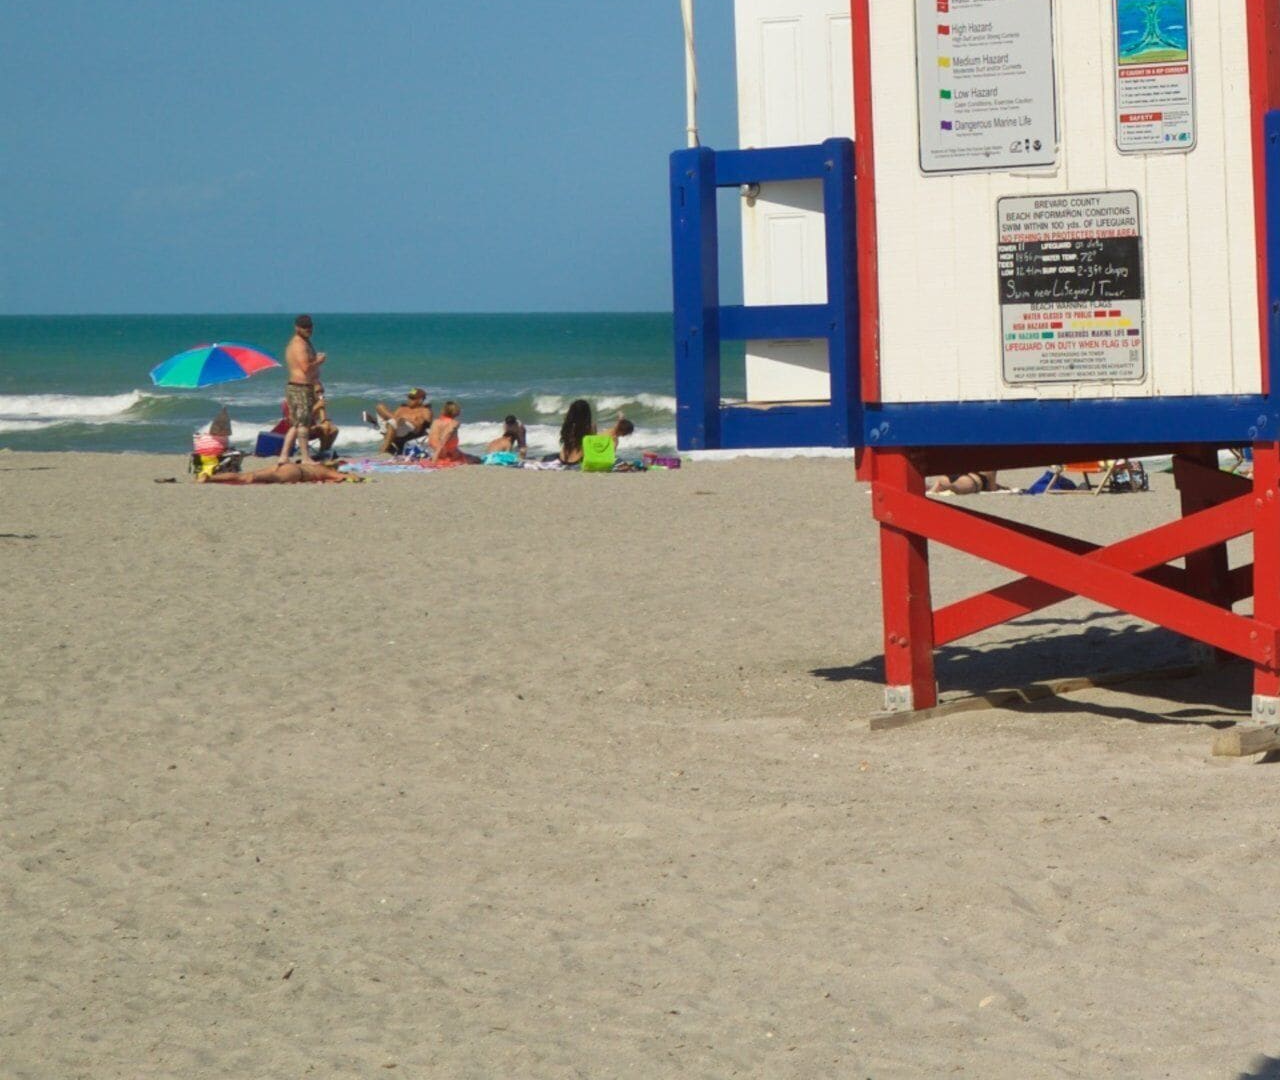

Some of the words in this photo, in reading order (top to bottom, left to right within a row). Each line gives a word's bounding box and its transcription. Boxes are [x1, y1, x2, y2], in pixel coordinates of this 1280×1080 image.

[952, 23, 967, 36] High
[968, 22, 993, 32] Hazard
[953, 56, 981, 67] Medium
[982, 53, 1009, 64] Hazard
[954, 88, 970, 99] Low
[971, 87, 998, 98] Hazard
[955, 120, 993, 132] Dangerous
[994, 117, 1018, 128] Marine
[1019, 115, 1033, 126] Life
[1129, 114, 1154, 122] SAFETY
[1035, 200, 1067, 210] BREVARD
[1070, 198, 1101, 208] COUNTY
[1006, 212, 1031, 222] BEACH
[1033, 209, 1082, 220] INFORMATION
[1085, 206, 1130, 217] CONDITIONS
[1002, 223, 1021, 232] SWIM
[1023, 221, 1049, 231] WITHIN
[1051, 220, 1064, 230] 100
[1067, 220, 1080, 230] yds.
[1084, 219, 1094, 228] OF
[1096, 217, 1136, 228] LIFEGUARD
[1002, 234, 1013, 243] NO
[1015, 232, 1041, 242] FISHING
[1043, 231, 1051, 240] IN
[1052, 229, 1094, 240] PROTECTED
[1095, 228, 1116, 238] SWIM
[1117, 227, 1137, 237] AREA
[1041, 241, 1072, 250] LIFEGUARD
[1006, 279, 1030, 299] Swim
[1034, 289, 1052, 298] near
[1052, 279, 1096, 299] Lifeguard
[1030, 302, 1054, 312] BEACH
[1056, 301, 1088, 310] WARNING
[1023, 313, 1041, 321] WATER
[1043, 312, 1063, 320] CLOSED
[1073, 311, 1092, 319] PUBLIC
[1013, 323, 1026, 331] HIGH
[1027, 322, 1049, 330] HAZARD
[1005, 332, 1016, 340] LOW
[1019, 332, 1041, 340] HAZARD
[1057, 330, 1089, 339] DANGEROUS
[1091, 329, 1112, 338] MARINE
[1114, 328, 1125, 337] LIFE
[1005, 341, 1043, 352] LIFEGUARD
[1045, 341, 1056, 350] ON
[1057, 340, 1077, 350] DUTY
[1078, 339, 1100, 349] WHEN
[1102, 339, 1120, 348] FLAG
[1122, 338, 1130, 347] IS
[1131, 338, 1142, 347] UP
